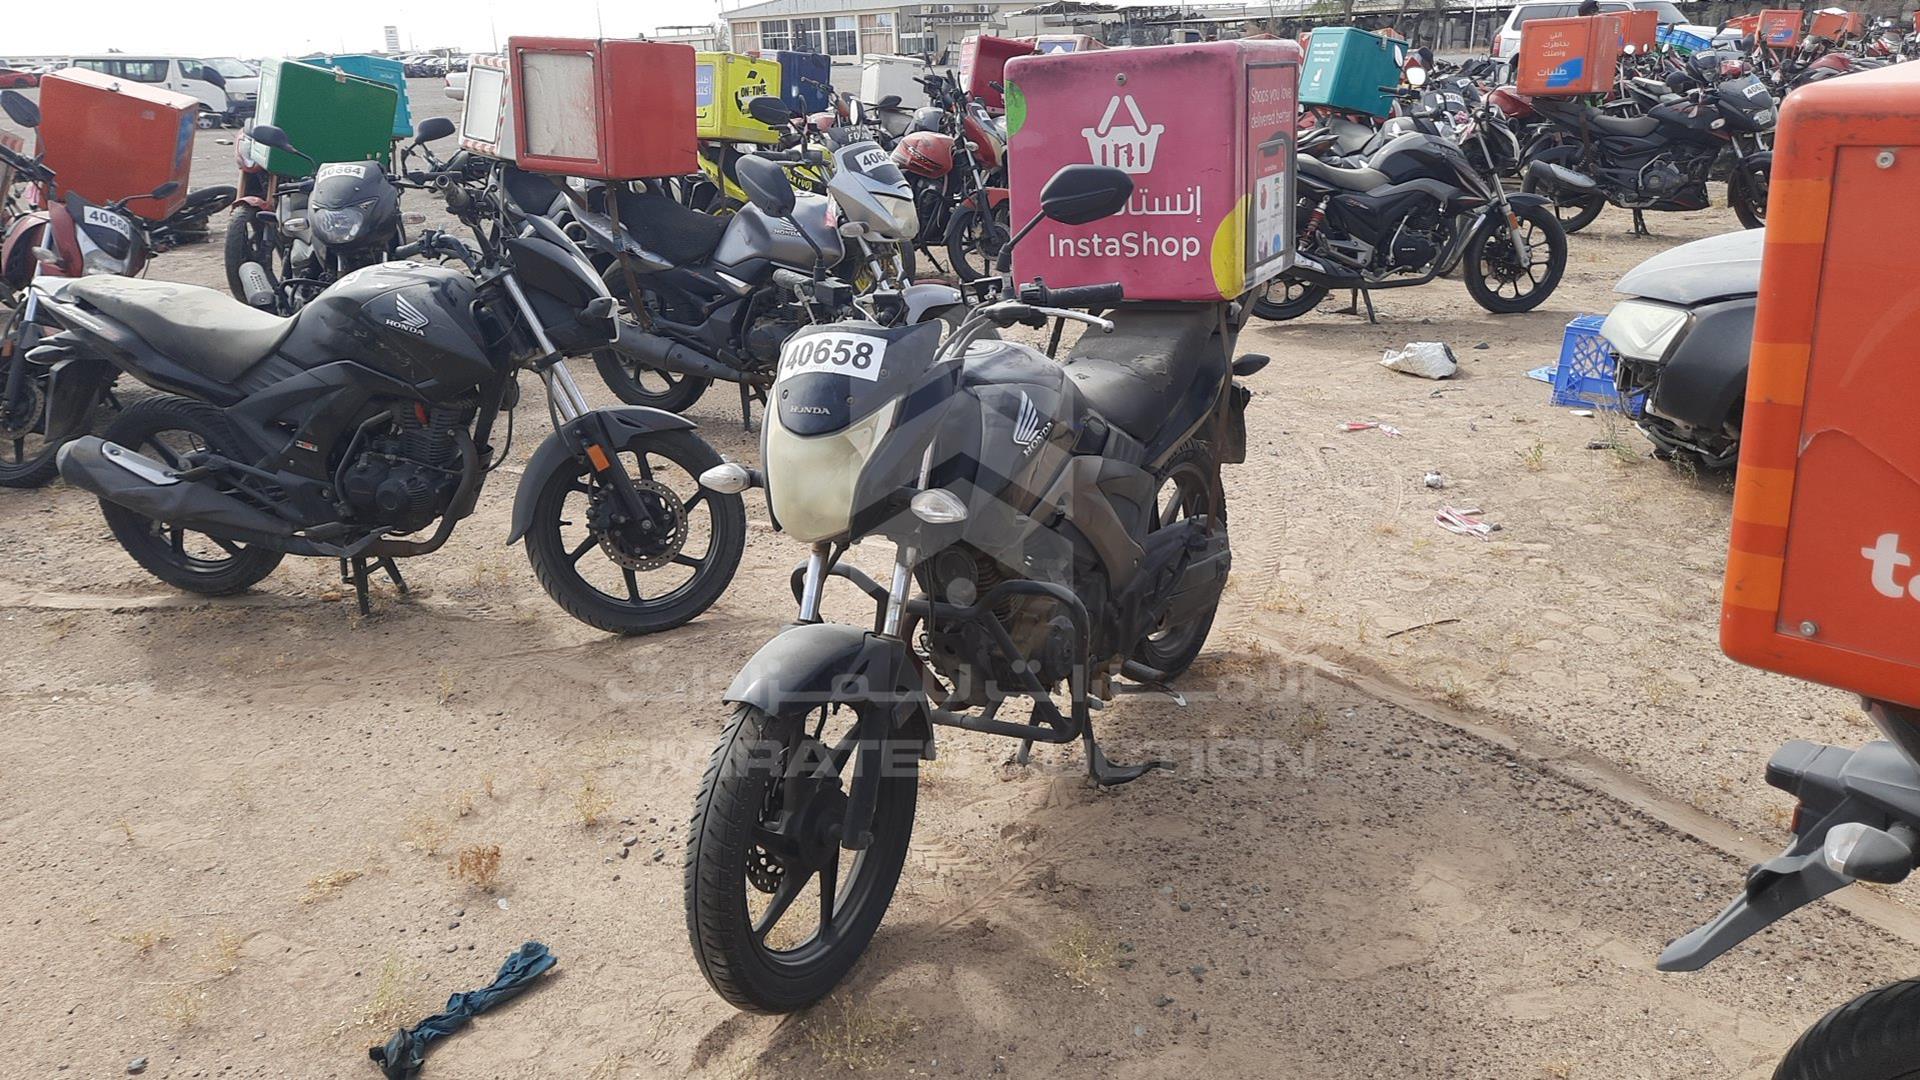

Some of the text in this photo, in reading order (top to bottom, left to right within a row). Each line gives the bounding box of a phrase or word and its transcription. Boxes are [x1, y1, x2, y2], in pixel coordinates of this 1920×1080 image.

[1049, 230, 1201, 262] InstaShop
[385, 319, 426, 337] HONDA
[785, 338, 874, 370] 40658
[1023, 421, 1053, 457] HONDA
